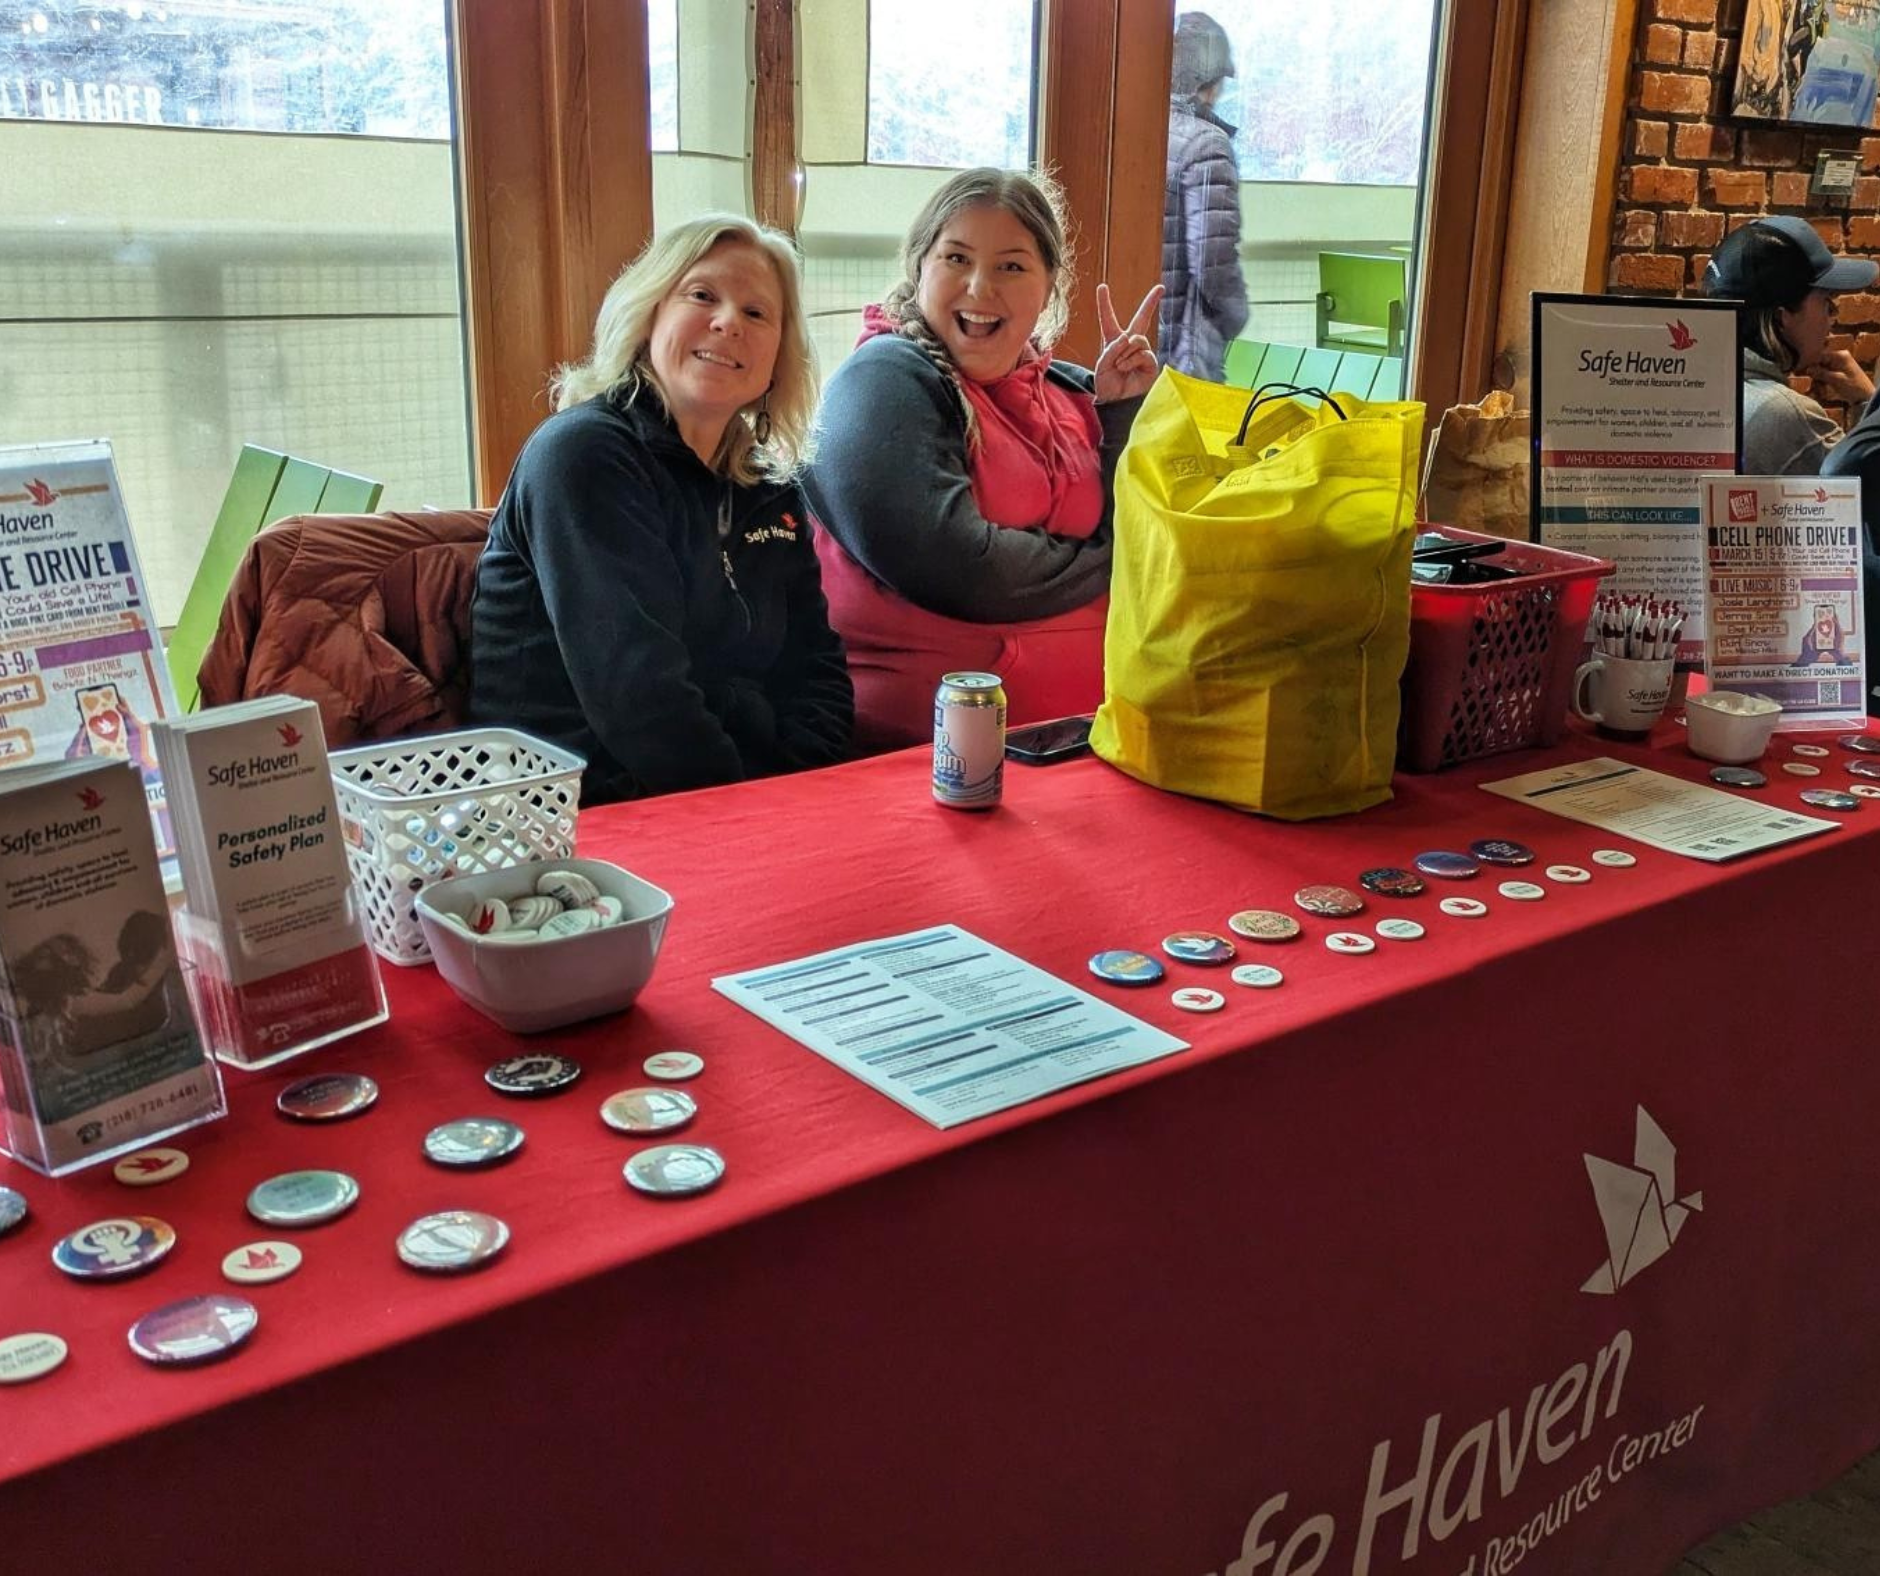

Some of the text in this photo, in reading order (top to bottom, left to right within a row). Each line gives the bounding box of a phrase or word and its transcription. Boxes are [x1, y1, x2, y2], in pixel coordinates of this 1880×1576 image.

[1579, 350, 1686, 378] Safe Haven
[1608, 376, 1706, 389] Shelter and Resource Center
[1565, 453, 1718, 467] WHAT IS DOMESTIC VIOLENCE?
[1586, 510, 1610, 521] THIS
[1611, 510, 1634, 521] CAN
[1635, 510, 1664, 522] LOOK
[1771, 503, 1793, 519] Safe
[1794, 503, 1825, 516] Haven
[744, 528, 770, 543] Safe
[1720, 526, 1847, 547] CELL PHONE DRIVE
[24, 542, 112, 588] DRIVE
[1721, 548, 1750, 561] MARCH
[3, 580, 122, 606] Your old Cell Phone
[1721, 579, 1742, 593] LIVE
[1743, 579, 1772, 592] MUSIC
[5, 602, 42, 617] Could
[46, 598, 74, 611] Save
[63, 658, 123, 679] FOOD PARTNER
[1714, 671, 1739, 679] WANT
[1740, 671, 1752, 679] TO
[1753, 670, 1776, 679] MAKE
[1785, 669, 1812, 677] DIRECT
[1813, 666, 1859, 677] DONATION?
[1626, 689, 1649, 702] Safe
[207, 761, 248, 788] Safe
[248, 752, 299, 777] Haven
[0, 828, 42, 856] Safe
[45, 815, 102, 842] Haven
[217, 805, 327, 850] Personalized
[229, 832, 325, 868] Safety Plan
[1203, 1329, 1634, 1576] fe Haven
[1481, 1403, 1706, 1576] Resource Center
